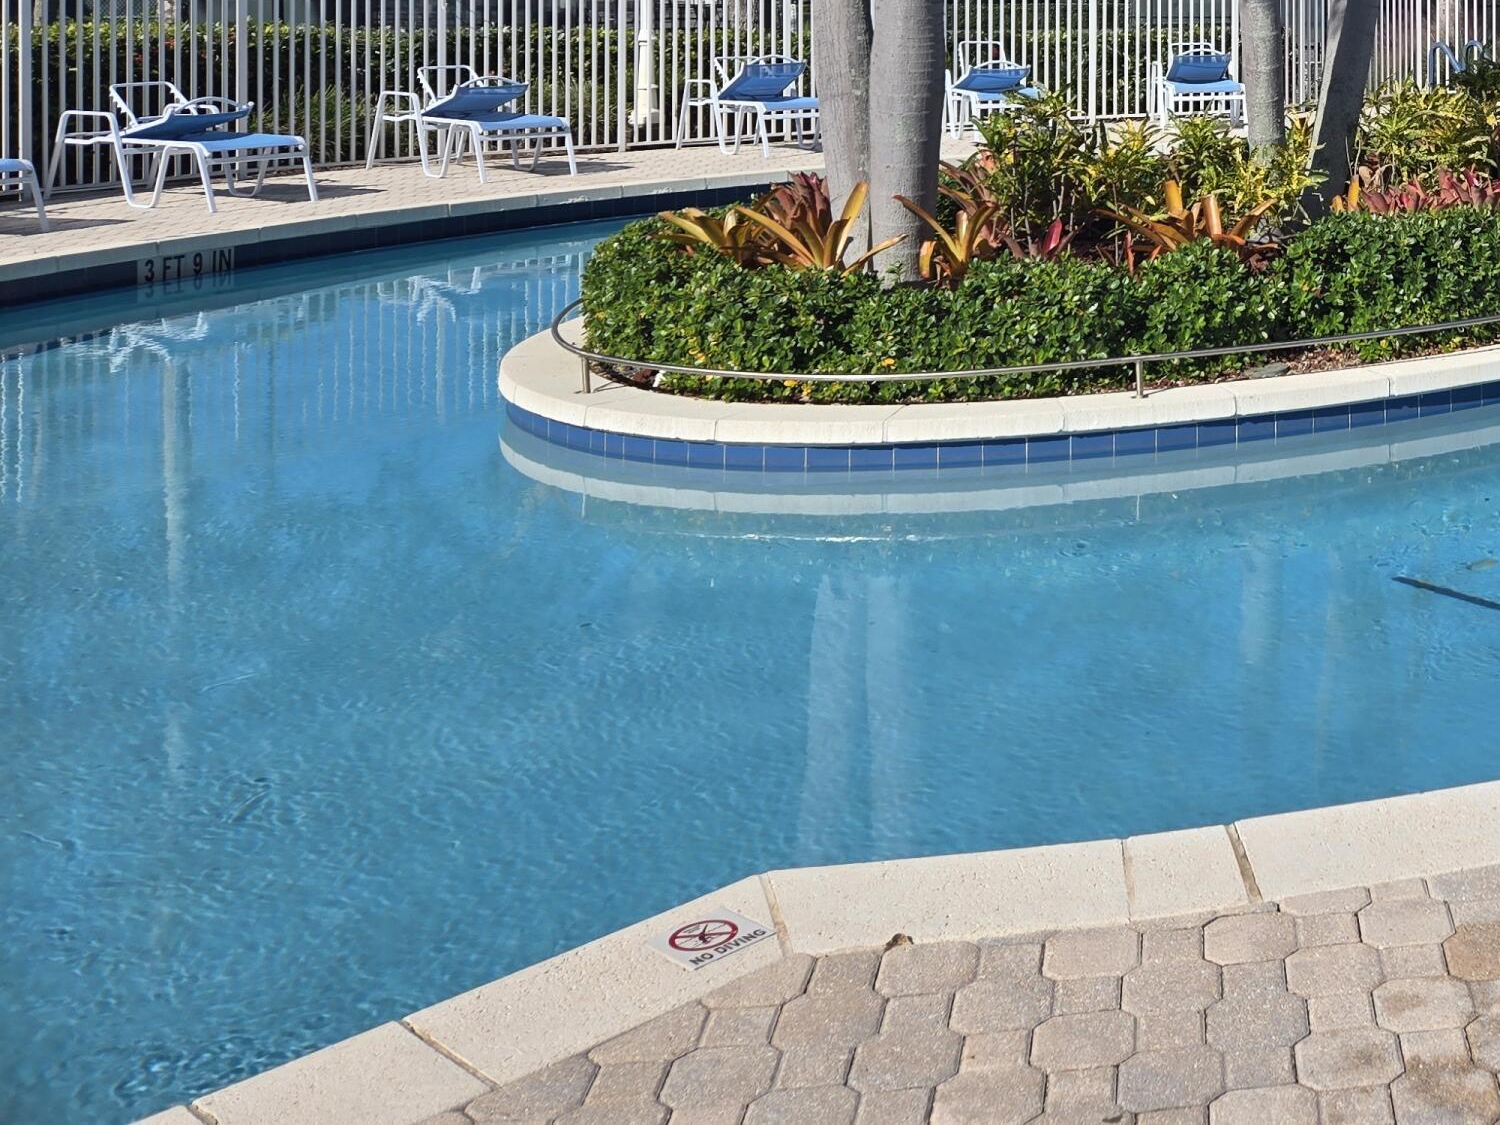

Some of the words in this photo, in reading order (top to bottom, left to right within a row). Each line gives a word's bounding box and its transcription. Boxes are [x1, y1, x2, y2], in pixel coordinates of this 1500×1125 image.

[144, 259, 155, 282] 3
[162, 255, 185, 281] FT
[193, 252, 203, 276] 9
[213, 249, 232, 273] IN
[689, 953, 714, 966] NO
[714, 929, 767, 954] DIVING
